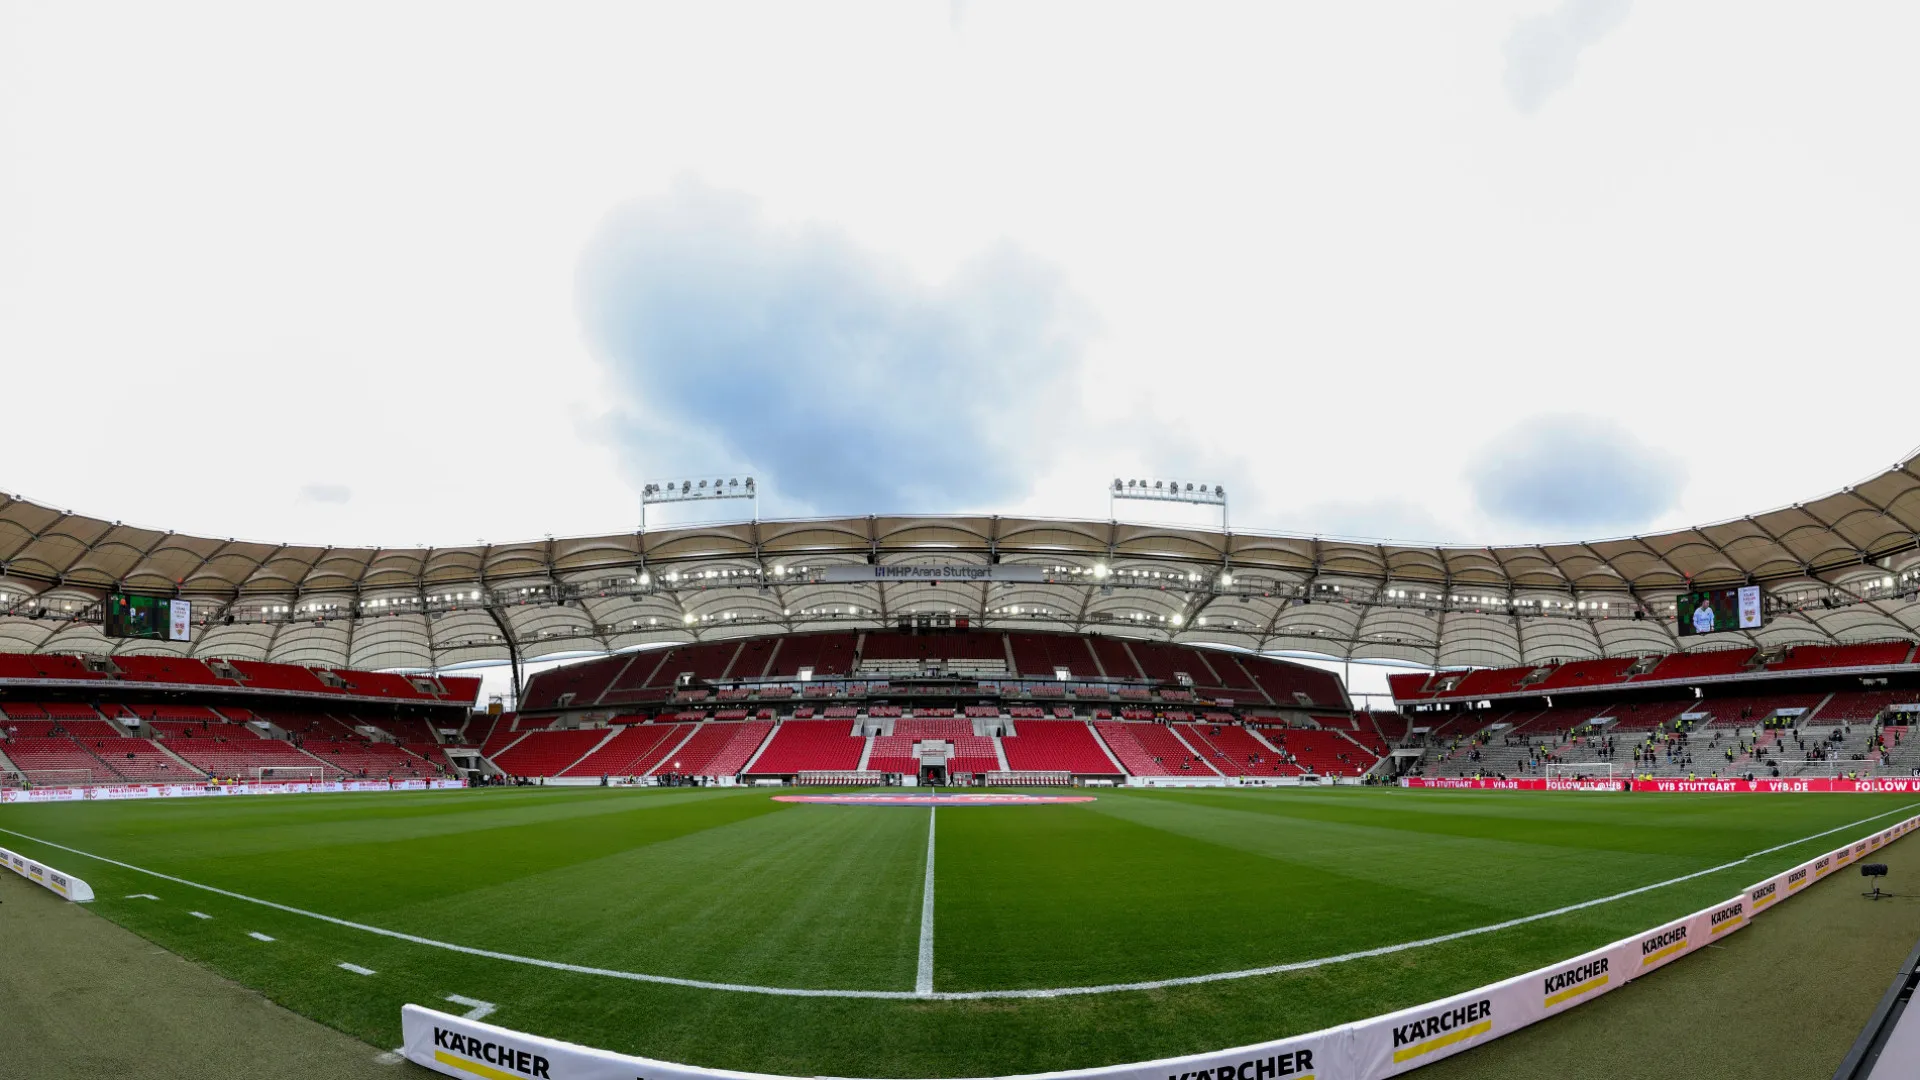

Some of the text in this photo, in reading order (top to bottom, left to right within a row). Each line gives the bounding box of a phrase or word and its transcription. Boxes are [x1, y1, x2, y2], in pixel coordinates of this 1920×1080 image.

[886, 567, 992, 579] MHP Arena Stuttgart
[1547, 781, 1580, 789] FOLLOW
[1657, 782, 1737, 791] VfB STUTTGART
[1769, 782, 1809, 791] VfB.DE
[1855, 781, 1908, 791] FOLLOW
[1788, 868, 1807, 884] KÄRCHER
[1752, 882, 1776, 901] KÄRCHER
[1711, 903, 1743, 926] KÄRCHER
[1642, 926, 1687, 955] KÄRCHER
[1544, 957, 1609, 995] KÄRCHER
[1392, 999, 1492, 1048] KÄRCHER
[433, 1026, 551, 1080] KÄRCHER
